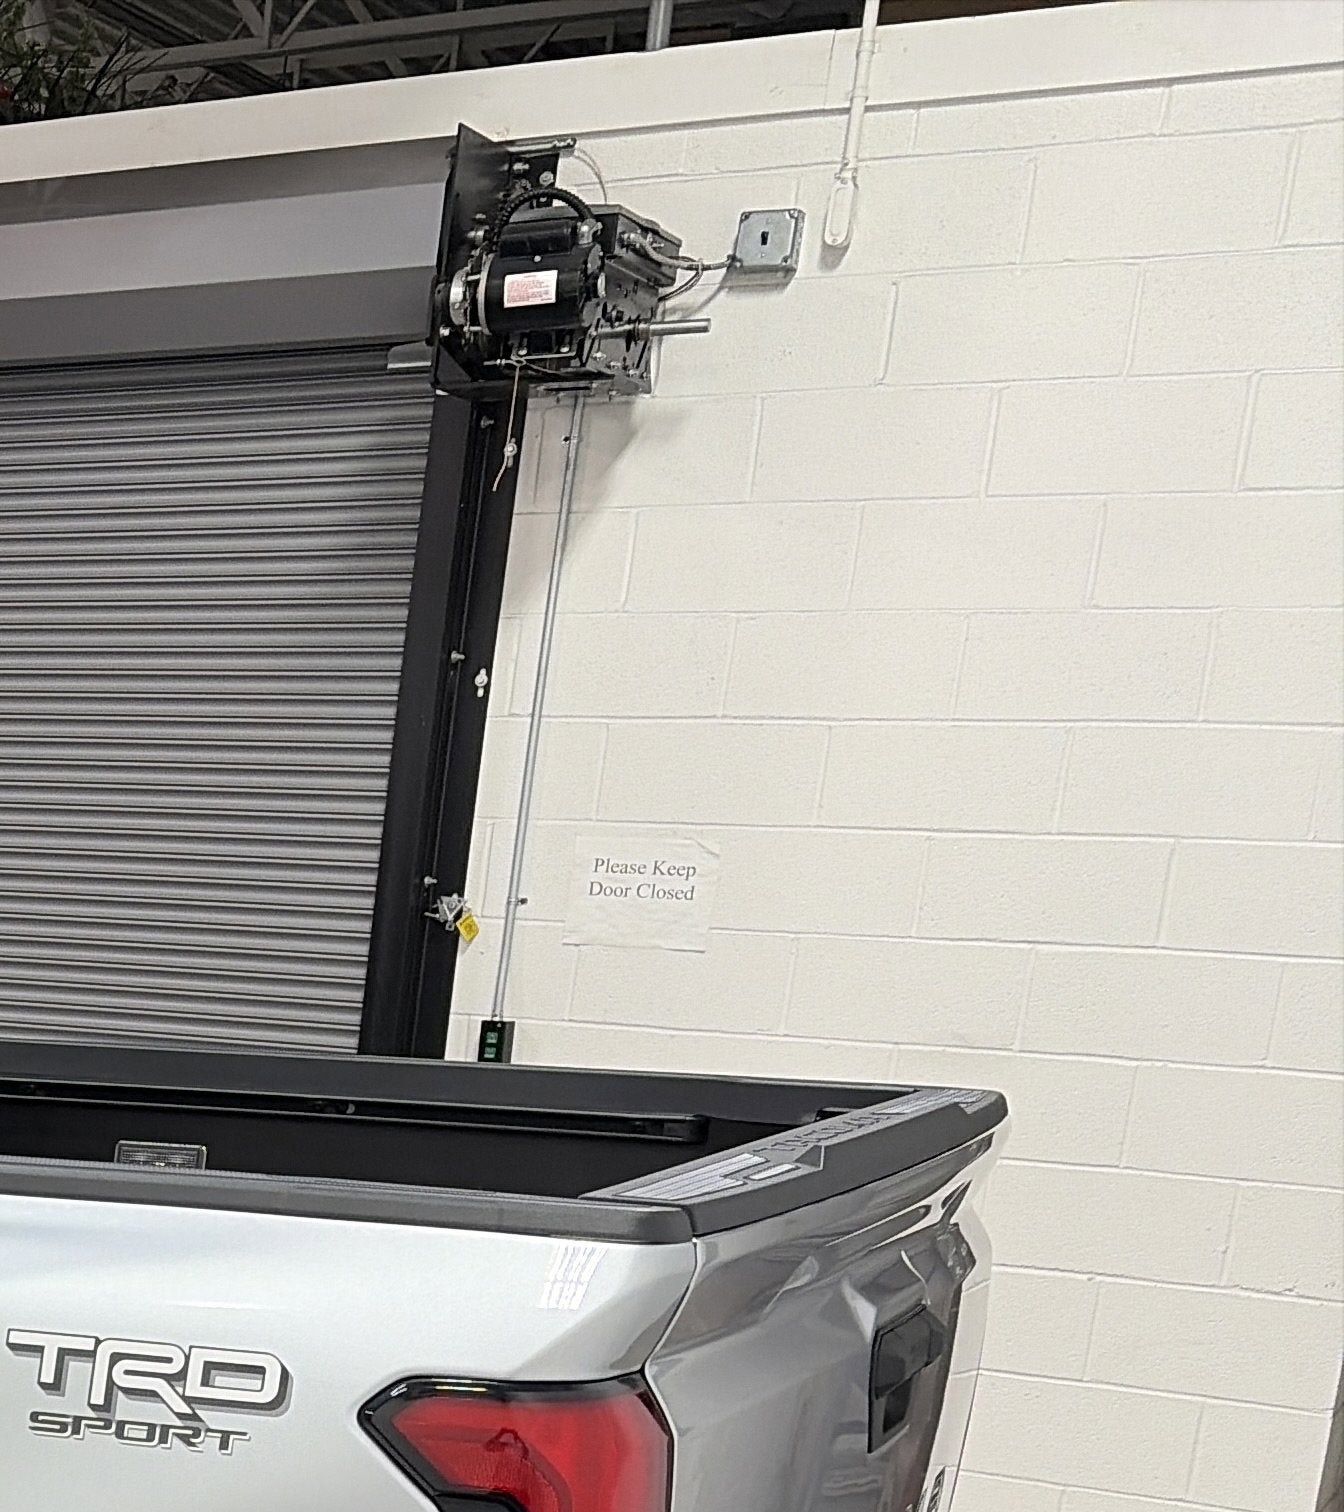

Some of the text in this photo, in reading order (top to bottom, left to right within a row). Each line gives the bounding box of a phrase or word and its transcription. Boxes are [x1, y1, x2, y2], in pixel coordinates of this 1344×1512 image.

[593, 857, 697, 881] Please Keep
[588, 881, 695, 901] Door Closed
[6, 1328, 292, 1422] TRD
[28, 1410, 251, 1455] SPORT
